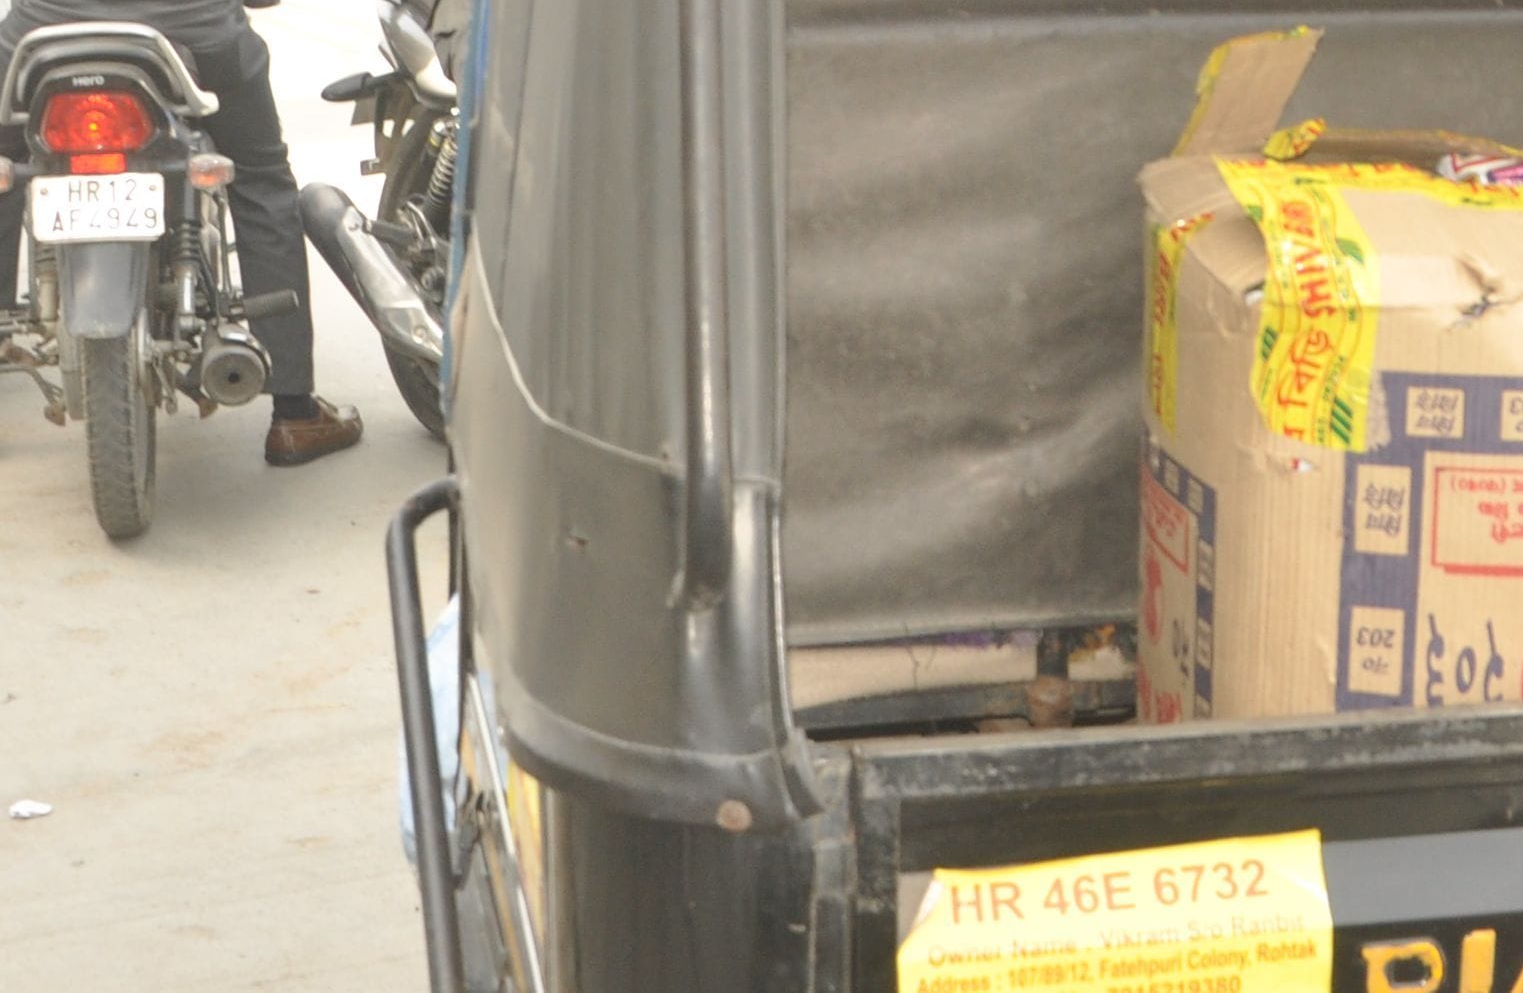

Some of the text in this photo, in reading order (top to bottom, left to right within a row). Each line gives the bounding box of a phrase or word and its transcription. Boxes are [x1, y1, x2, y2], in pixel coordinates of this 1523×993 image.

[72, 75, 105, 87] Hero
[950, 858, 1269, 925] HR 46E 6732
[1099, 953, 1183, 981] Fatehpuri
[1256, 939, 1317, 963] Rohtak
